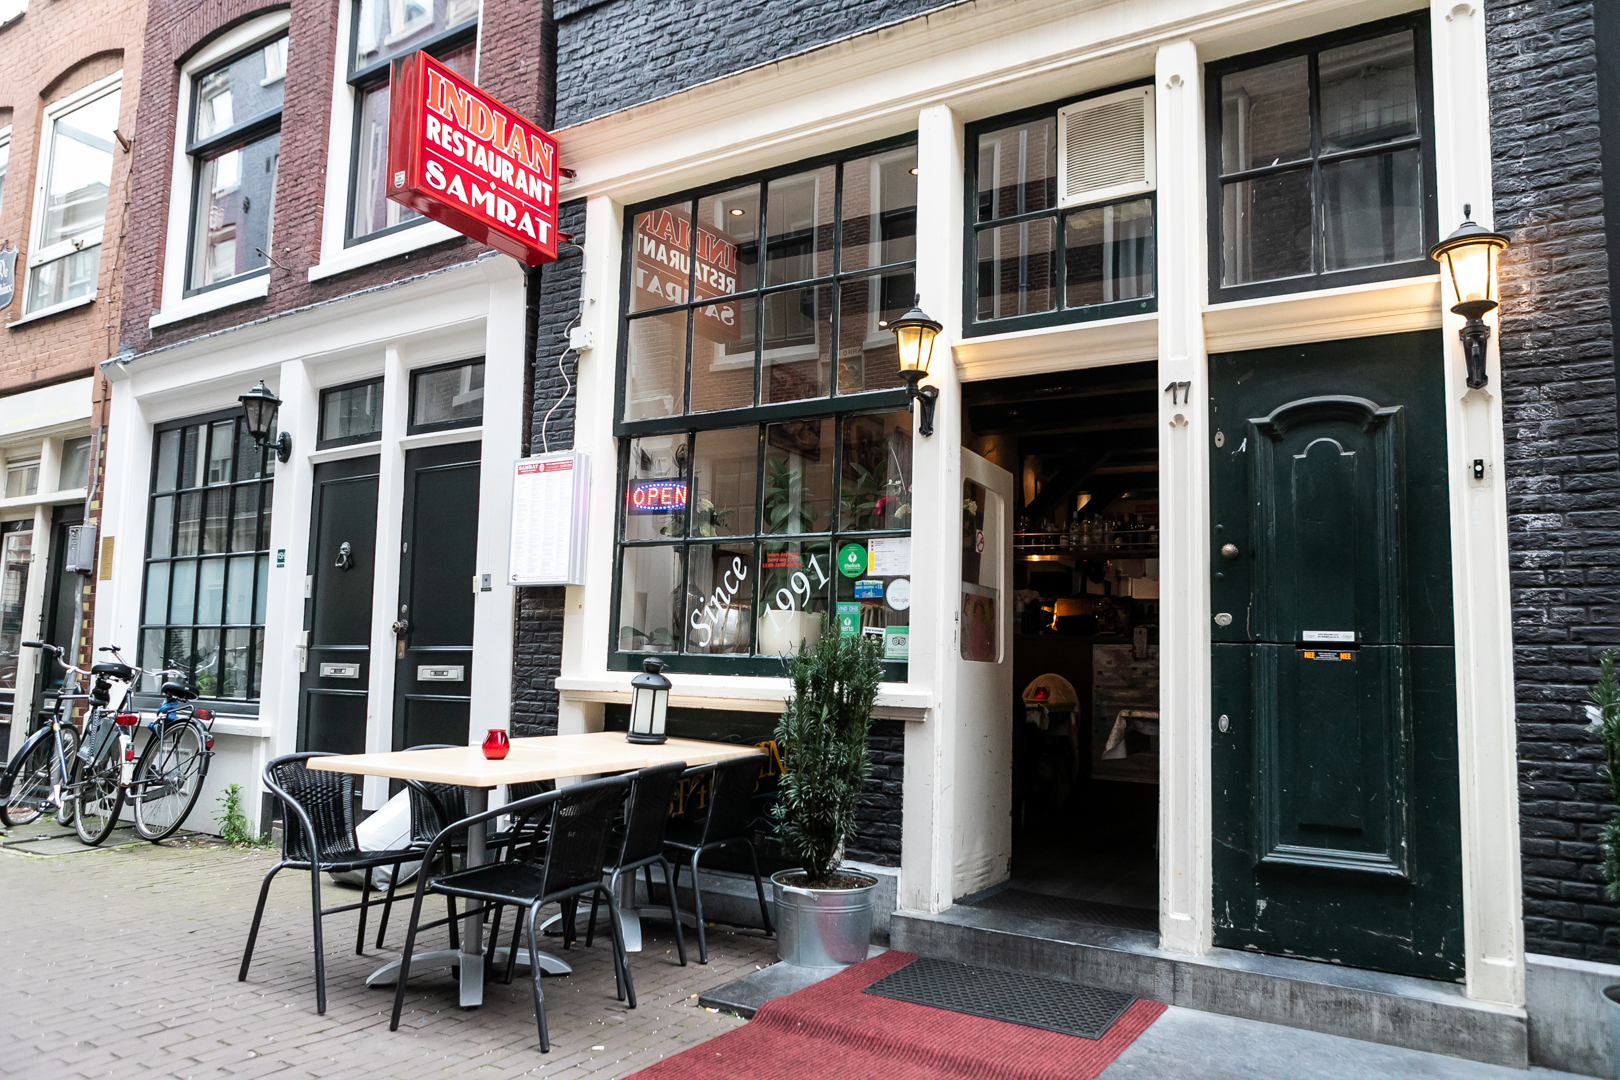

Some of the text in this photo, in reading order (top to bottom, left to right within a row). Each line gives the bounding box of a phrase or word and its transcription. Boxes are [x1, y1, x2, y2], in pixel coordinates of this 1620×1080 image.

[427, 68, 553, 180] INDIAN
[427, 114, 552, 206] RESTAURANT
[425, 160, 551, 244] SAMRAT
[1164, 381, 1191, 405] 17
[632, 486, 687, 505] OPEN
[690, 556, 747, 647] Since
[763, 553, 829, 638] 1991
[891, 596, 909, 604] Google
